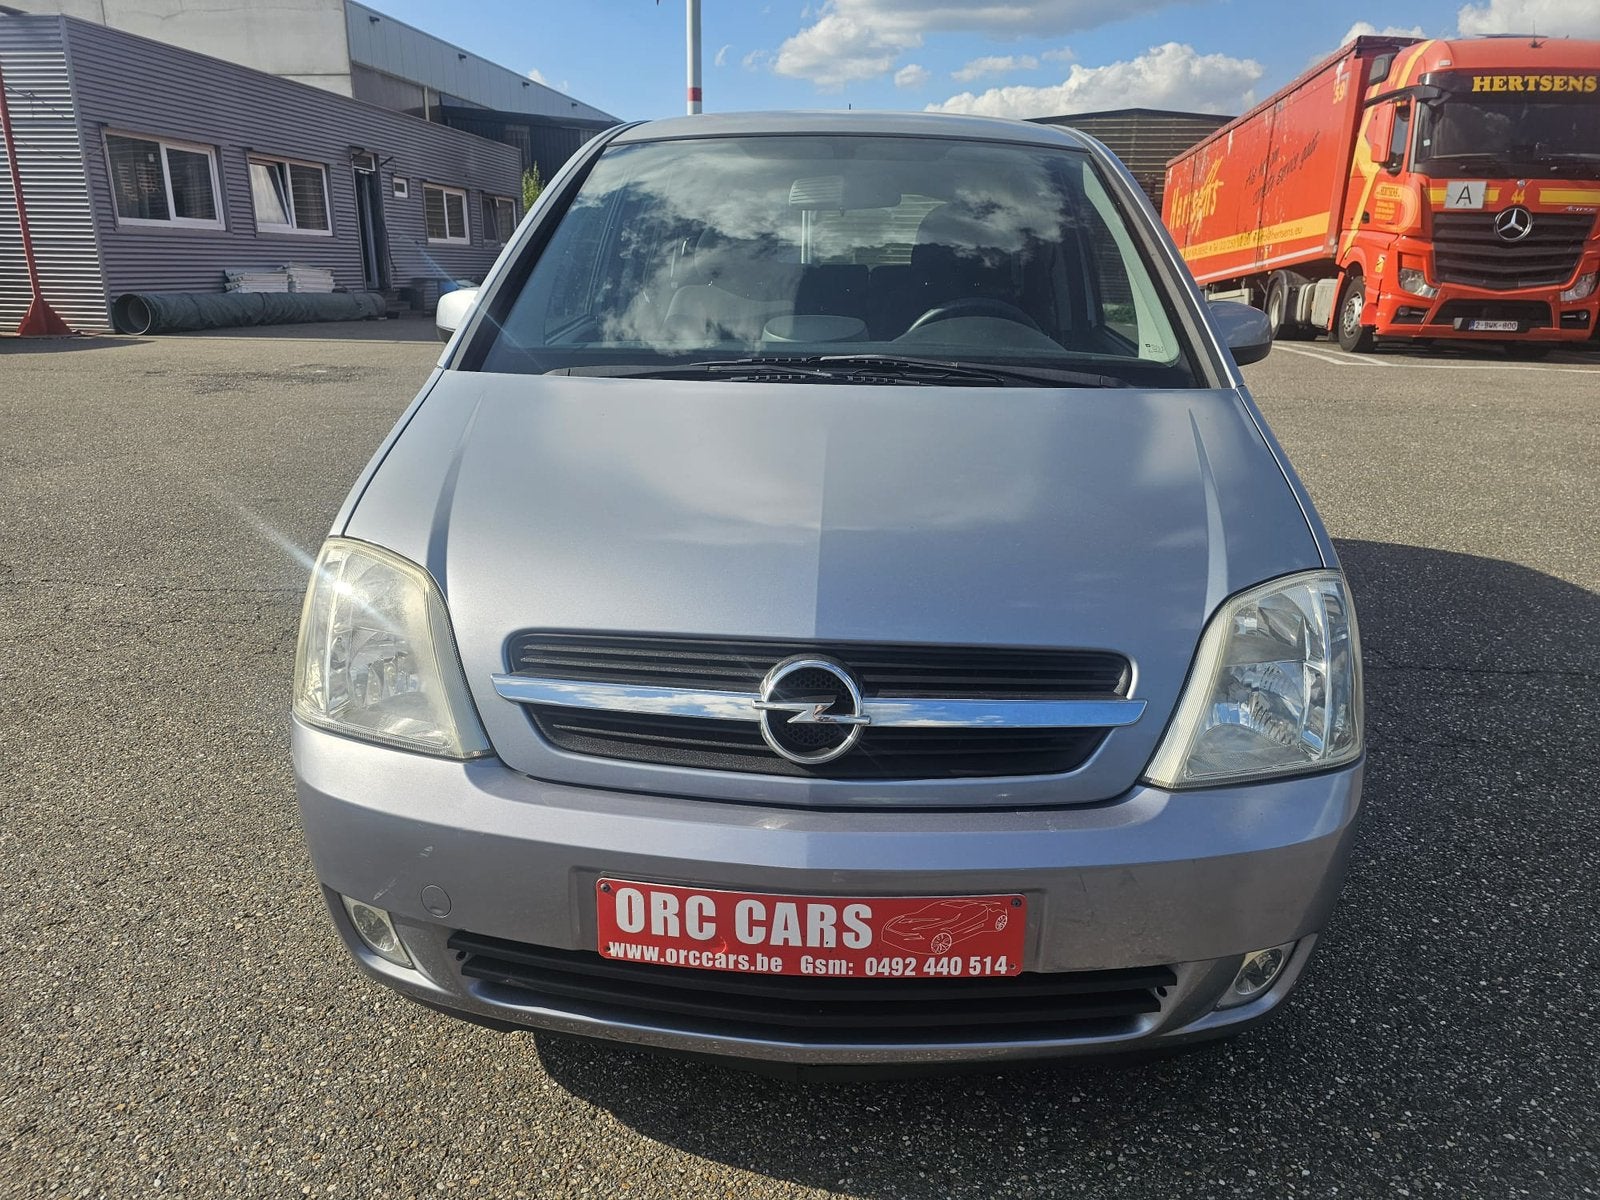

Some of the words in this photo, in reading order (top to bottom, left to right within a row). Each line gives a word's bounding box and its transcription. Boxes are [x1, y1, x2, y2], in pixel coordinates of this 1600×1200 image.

[1472, 75, 1598, 93] HERTSENS
[1456, 184, 1473, 206] A
[615, 887, 717, 941] ORC
[735, 898, 873, 950] CARS
[608, 941, 783, 973] www.orccars.be
[800, 955, 854, 976] Gsm:
[865, 956, 916, 977] 0492
[923, 956, 963, 976] 440
[969, 955, 1008, 976] 514
